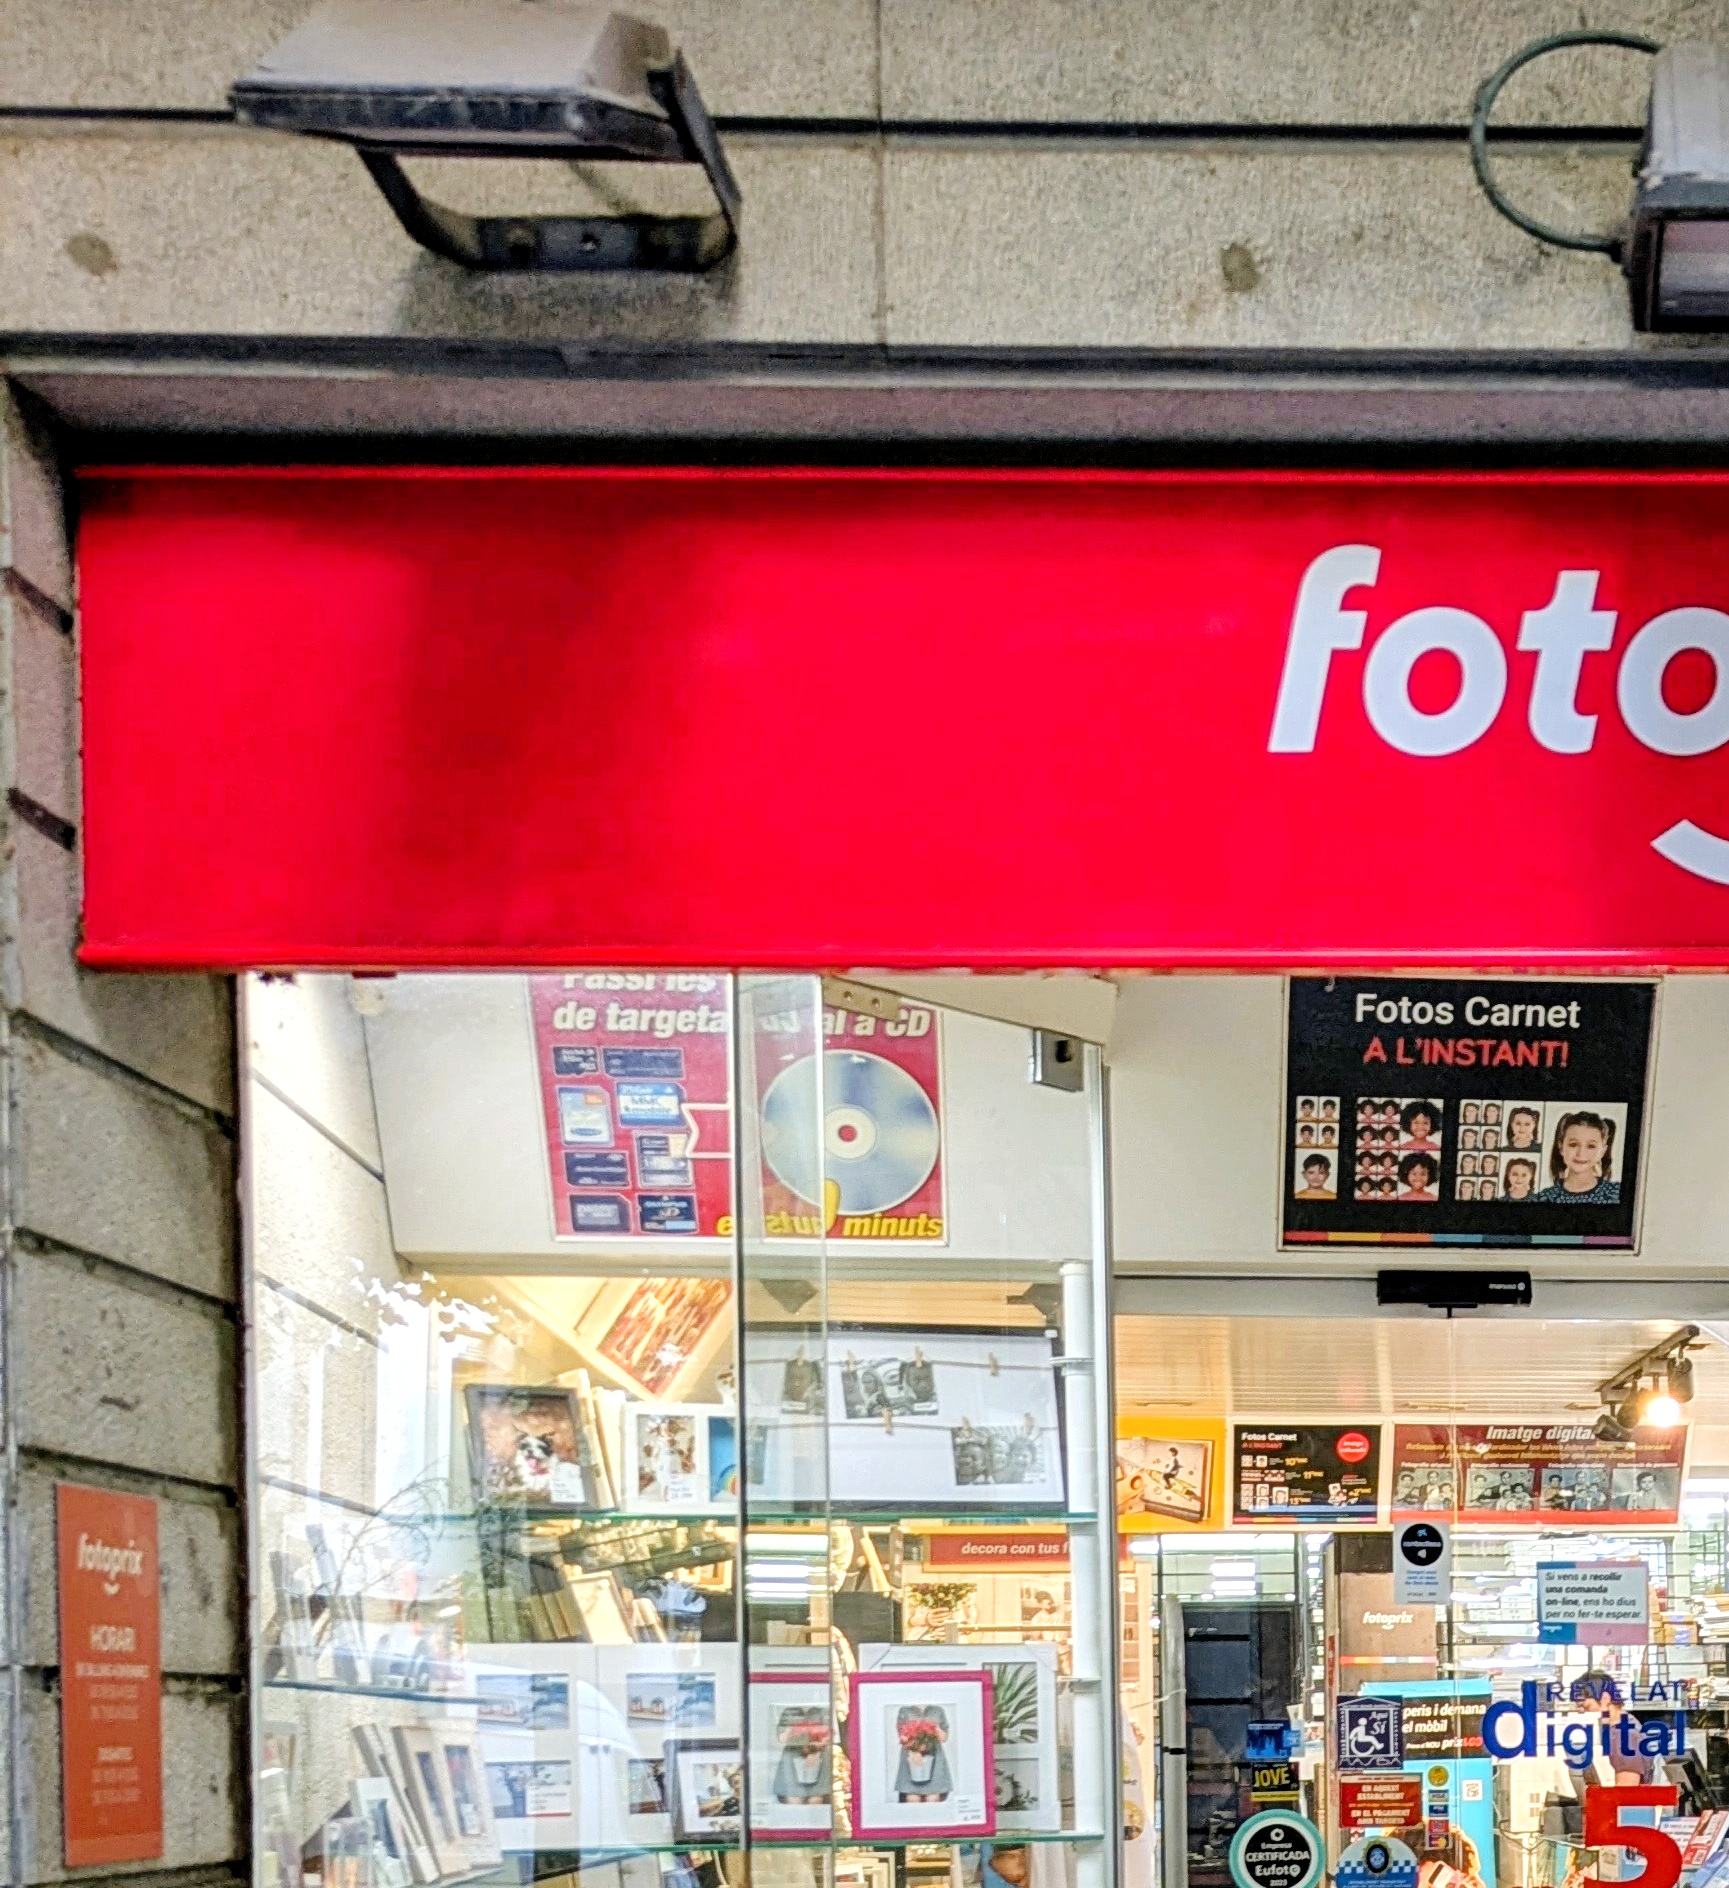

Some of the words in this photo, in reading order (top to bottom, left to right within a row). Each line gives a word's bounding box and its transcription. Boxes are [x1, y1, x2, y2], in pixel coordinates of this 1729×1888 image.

[553, 1001, 598, 1032] de
[1354, 992, 1455, 1027] Fotos
[1464, 996, 1581, 1029] Carnet
[1363, 1038, 1388, 1064] A
[1395, 1037, 1569, 1068] L'INSTANT!
[843, 1211, 943, 1238] minuts
[1486, 1426, 1542, 1441] Imatge
[1546, 1426, 1596, 1442] digita
[77, 1532, 143, 1580] fotoprix
[962, 1541, 1007, 1555] decora
[1010, 1544, 1034, 1555] con
[1037, 1542, 1060, 1555] tus
[1565, 1584, 1608, 1594] comanda
[1363, 1611, 1414, 1625] fotoprix
[1546, 1680, 1687, 1702] REVELAT
[1441, 1703, 1487, 1716] demana
[1482, 1680, 1687, 1770] digital
[1253, 1766, 1291, 1788] JOVE
[1245, 1850, 1311, 1863] CERTIFICADA
